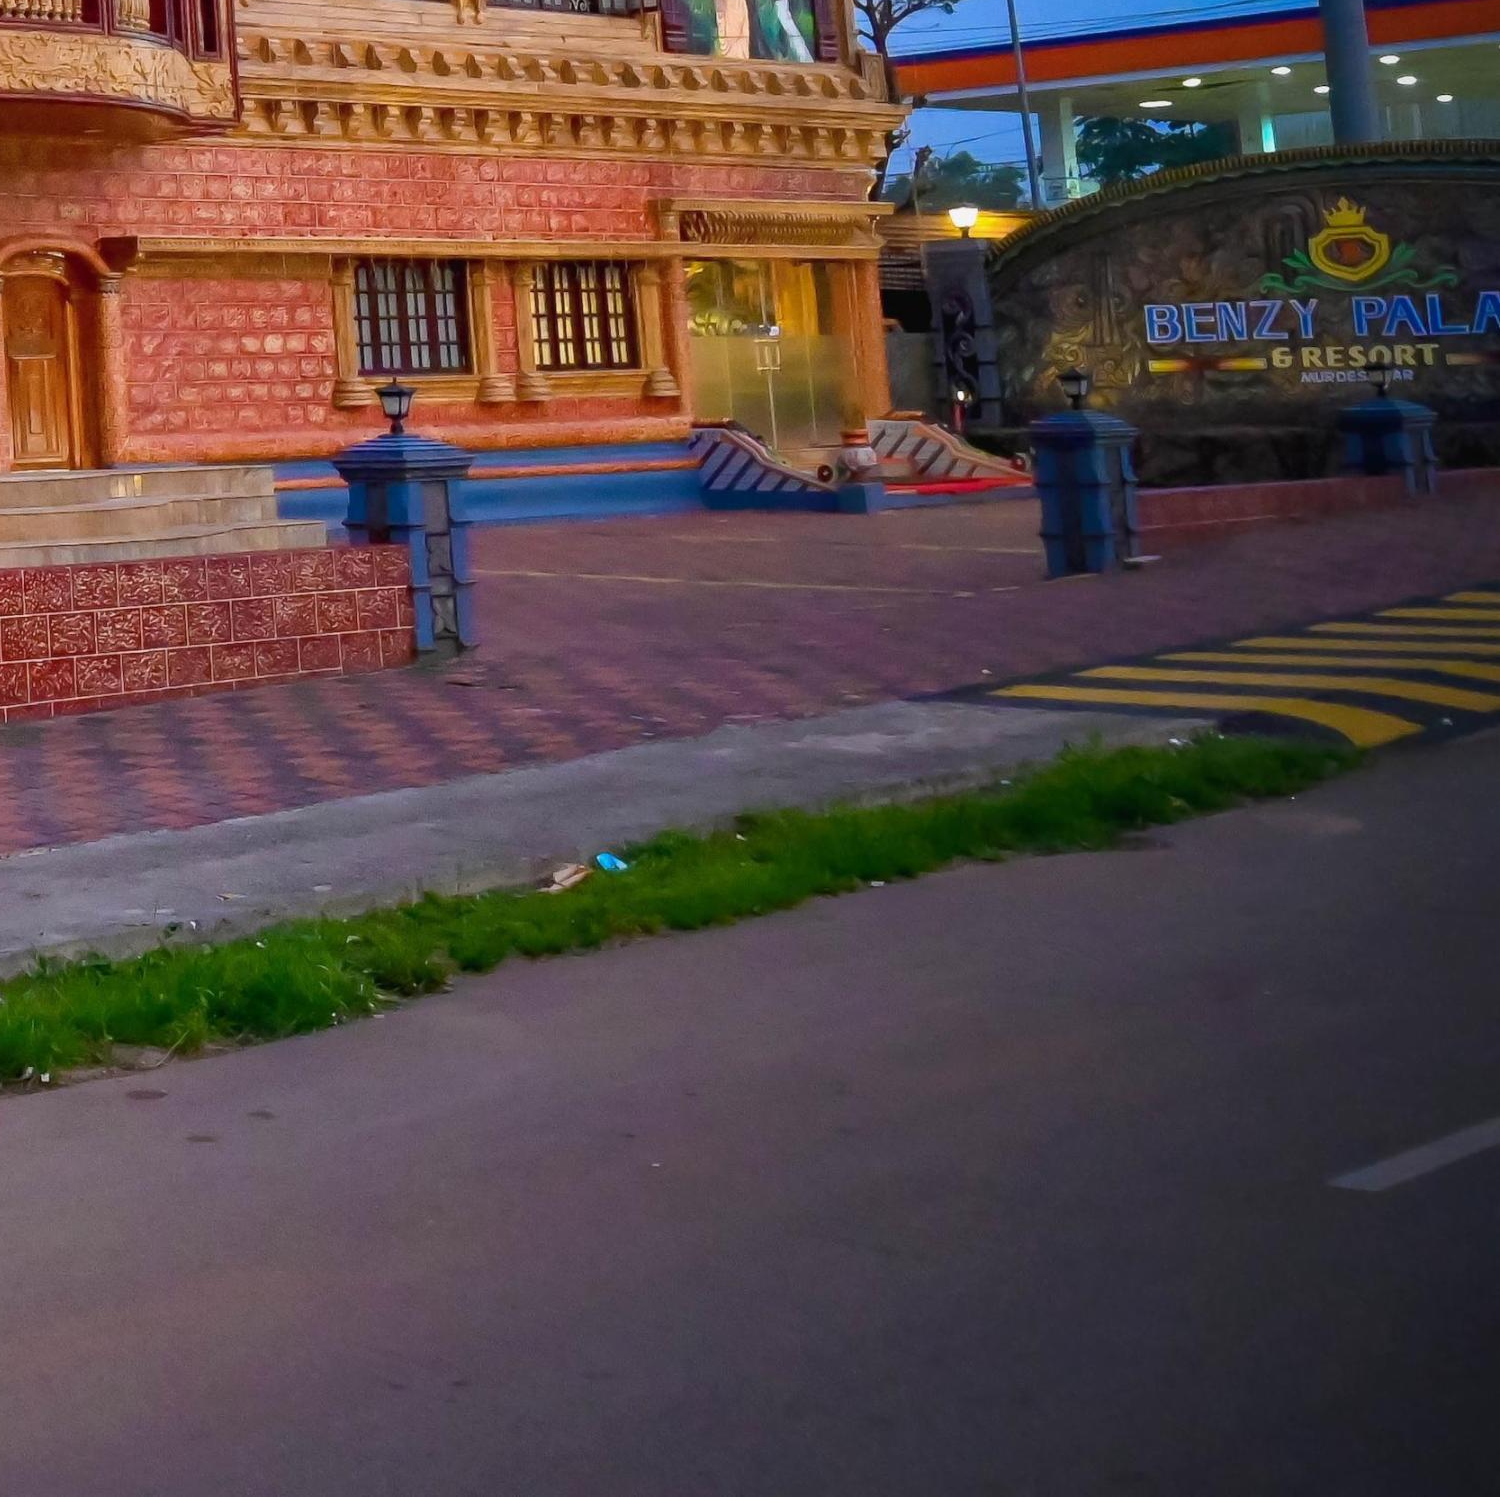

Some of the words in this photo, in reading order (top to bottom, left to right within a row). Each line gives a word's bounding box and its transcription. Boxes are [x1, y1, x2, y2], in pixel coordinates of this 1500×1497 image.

[1144, 298, 1318, 343] BENZY
[1351, 291, 1500, 336] PALA
[1302, 344, 1440, 368] RESORT
[1301, 369, 1415, 384] MURDESAR
